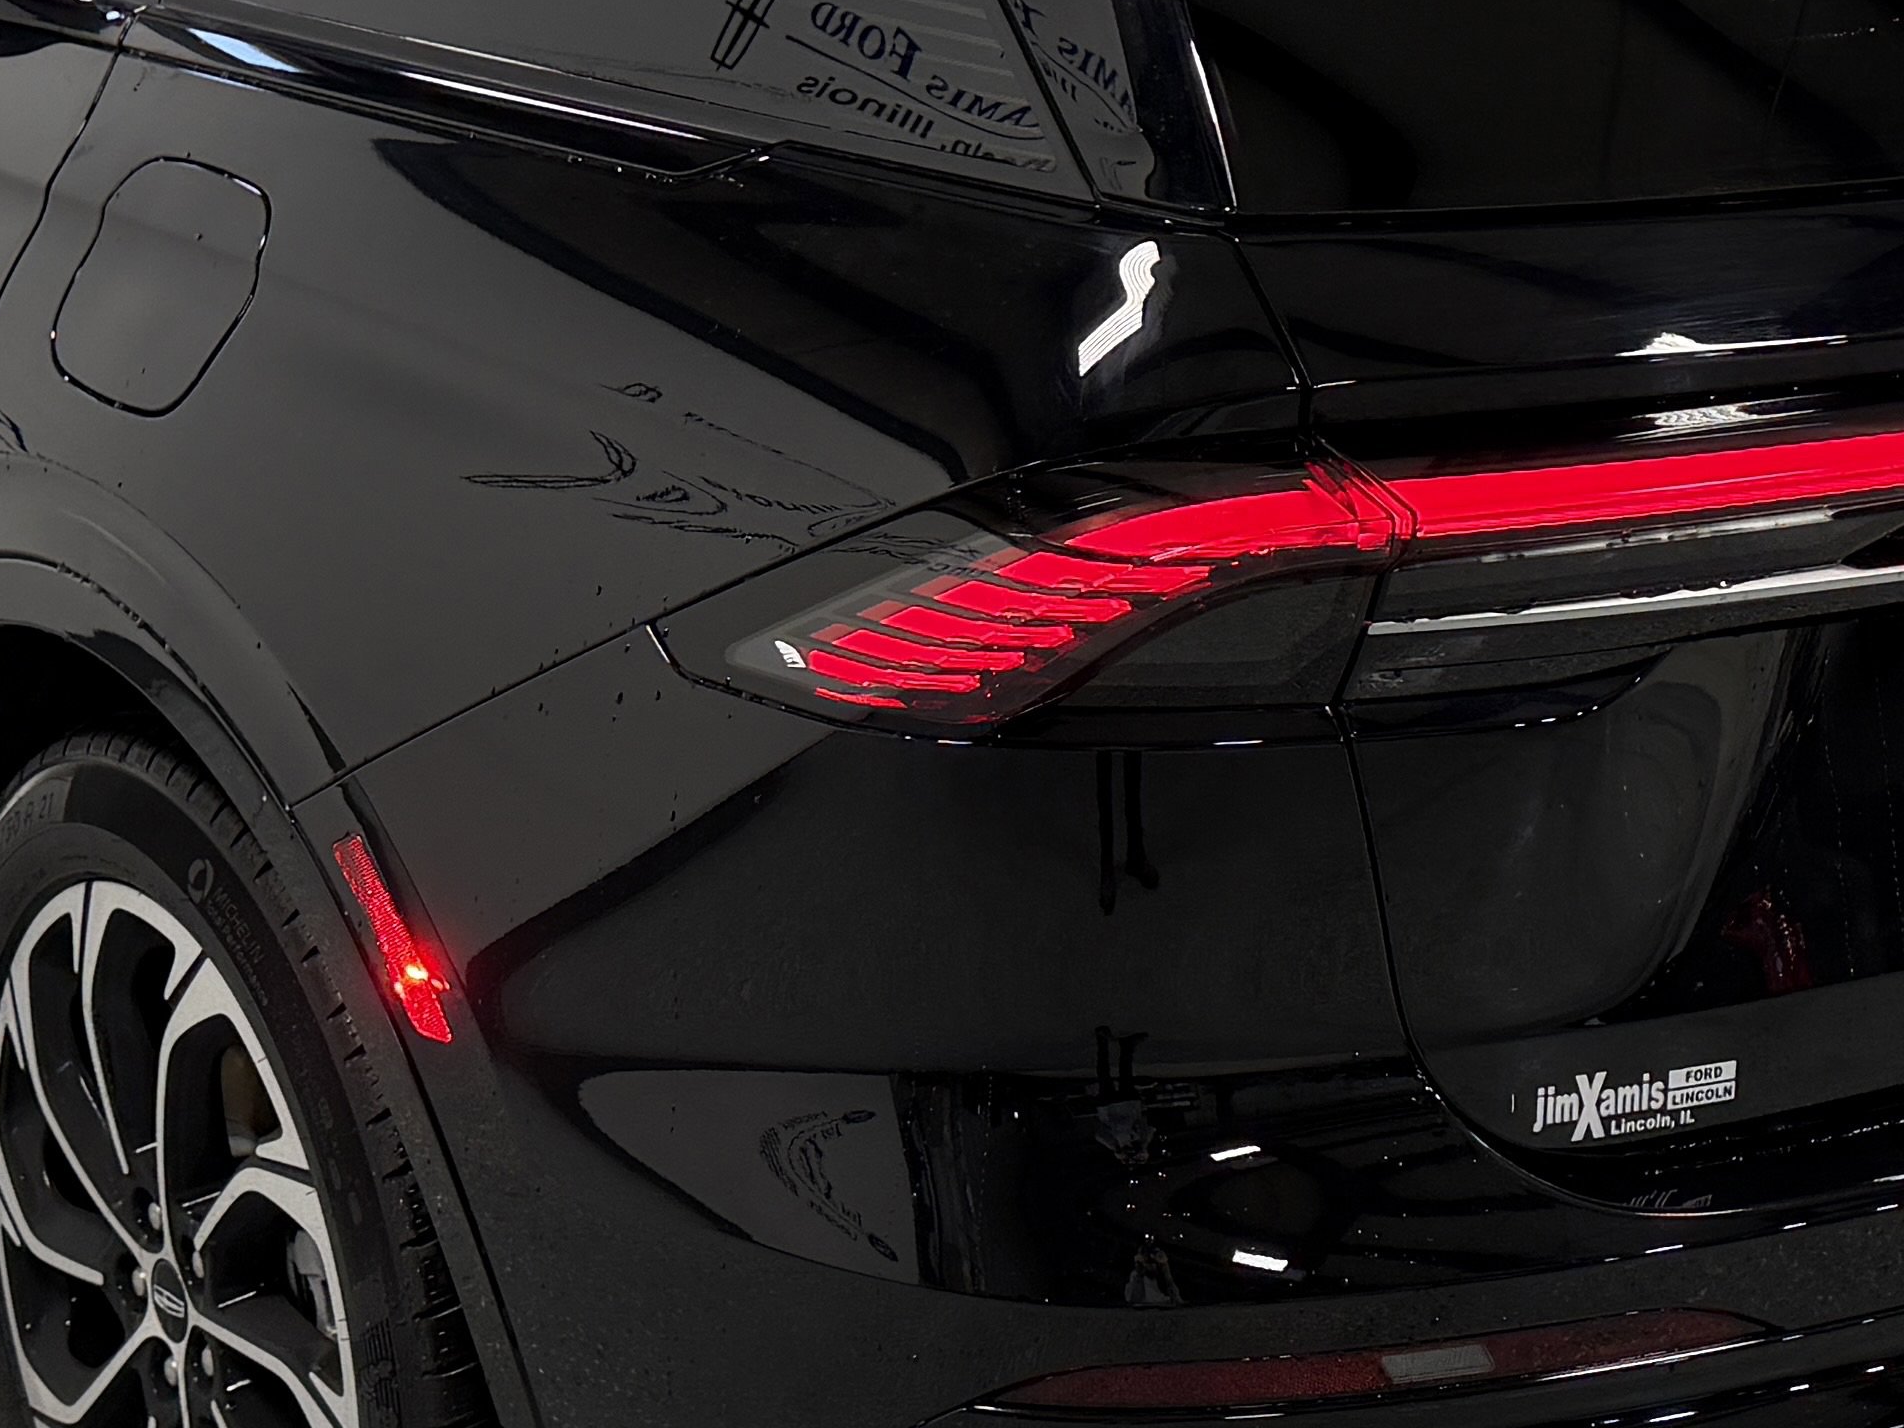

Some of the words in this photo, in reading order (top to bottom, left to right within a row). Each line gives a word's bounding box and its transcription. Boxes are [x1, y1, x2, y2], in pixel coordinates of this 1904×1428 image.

[1684, 1065, 1724, 1083] FORD
[1532, 1070, 1666, 1143] jimXamis
[1671, 1084, 1734, 1107] LINCOLN
[1609, 1112, 1676, 1136] Lincoln,
[1678, 1109, 1696, 1126] IL
